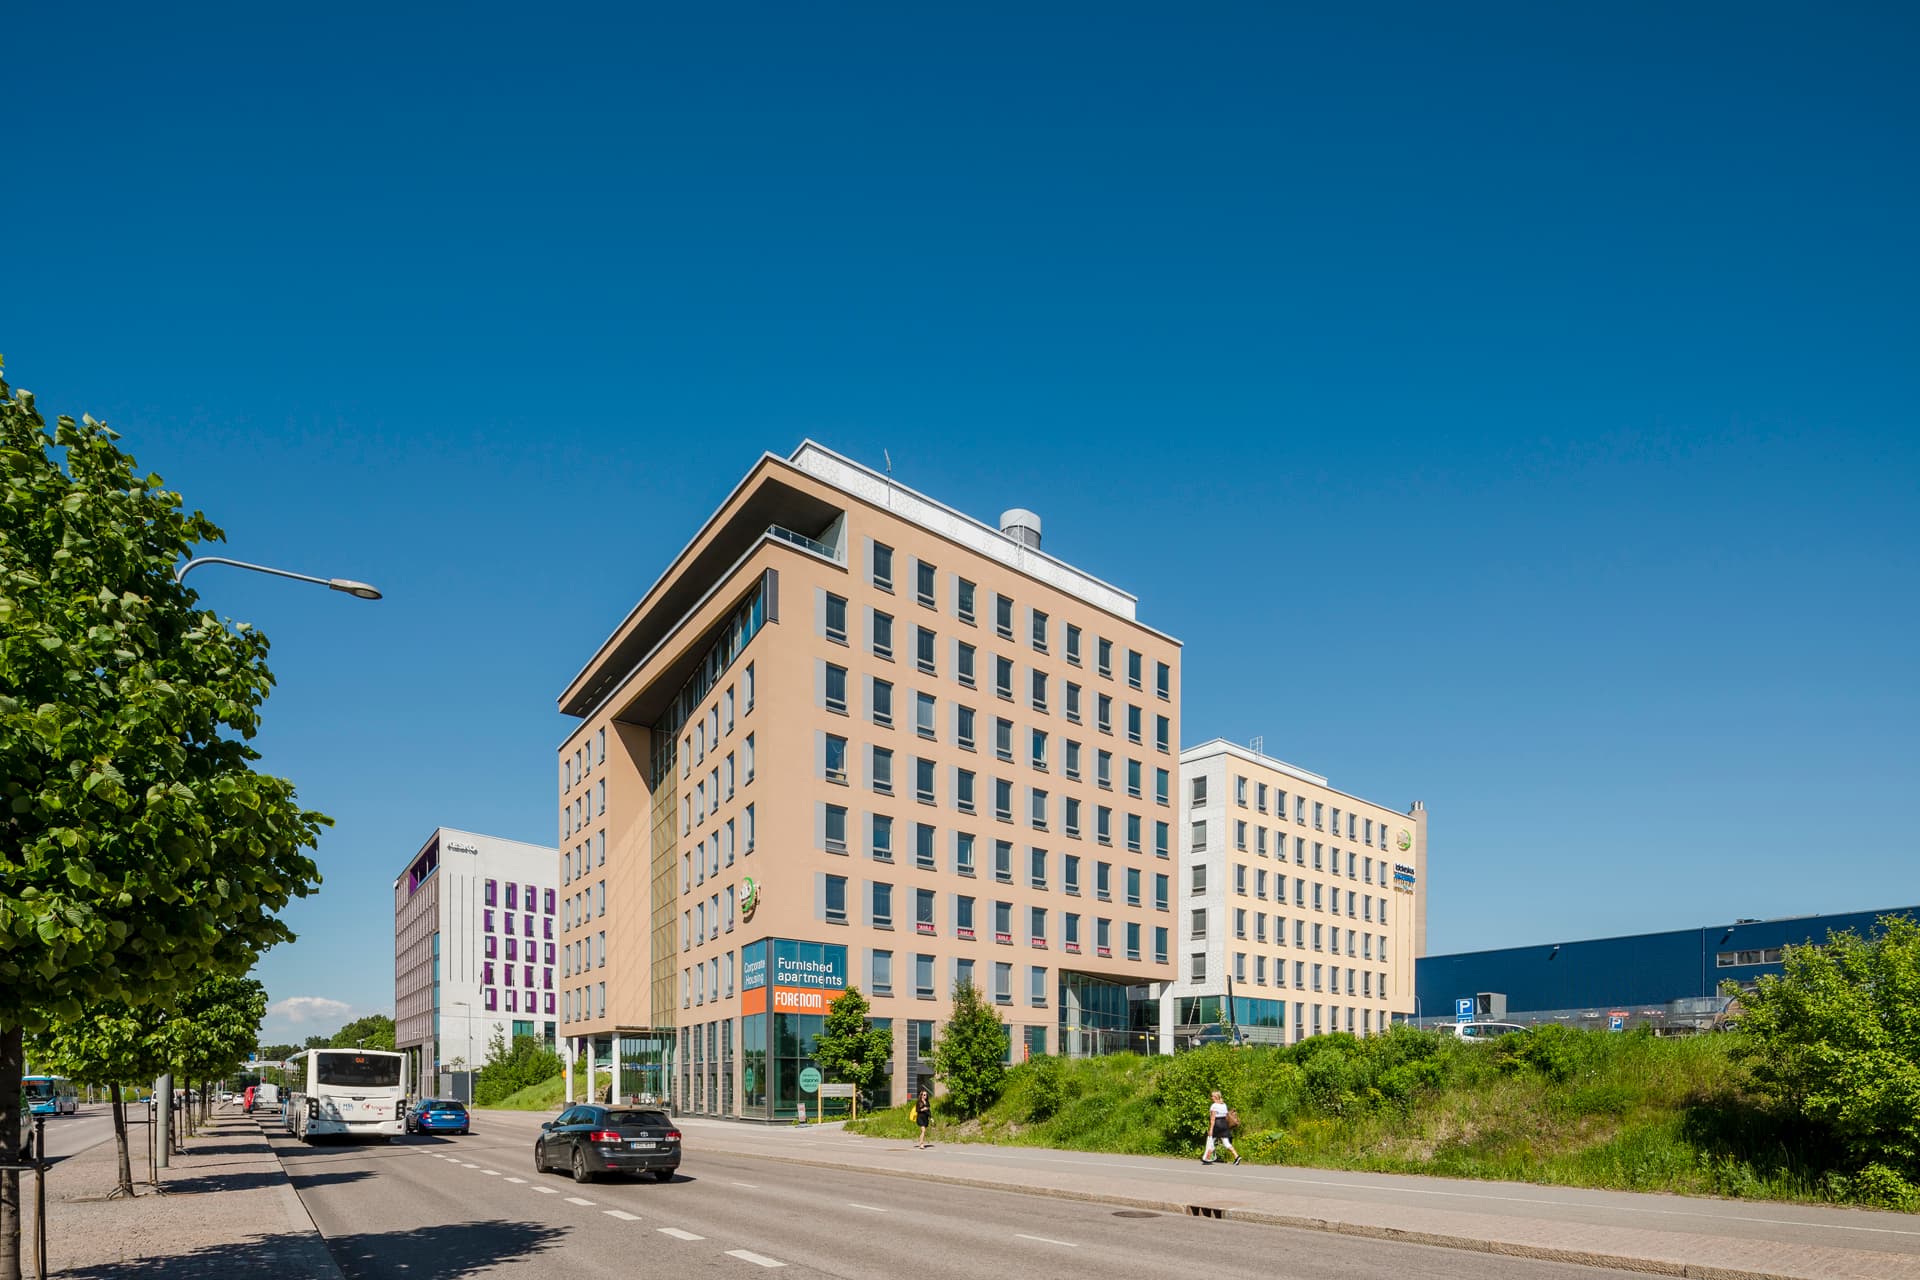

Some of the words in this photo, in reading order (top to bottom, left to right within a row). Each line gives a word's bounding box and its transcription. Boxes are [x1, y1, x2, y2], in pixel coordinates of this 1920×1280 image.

[744, 959, 766, 974] Corporate
[778, 957, 833, 973] Furnished
[745, 973, 764, 985] Housing
[778, 972, 843, 986] apartments
[775, 992, 822, 1008] FORENOM
[1459, 1000, 1471, 1014] P
[1611, 1017, 1621, 1029] P
